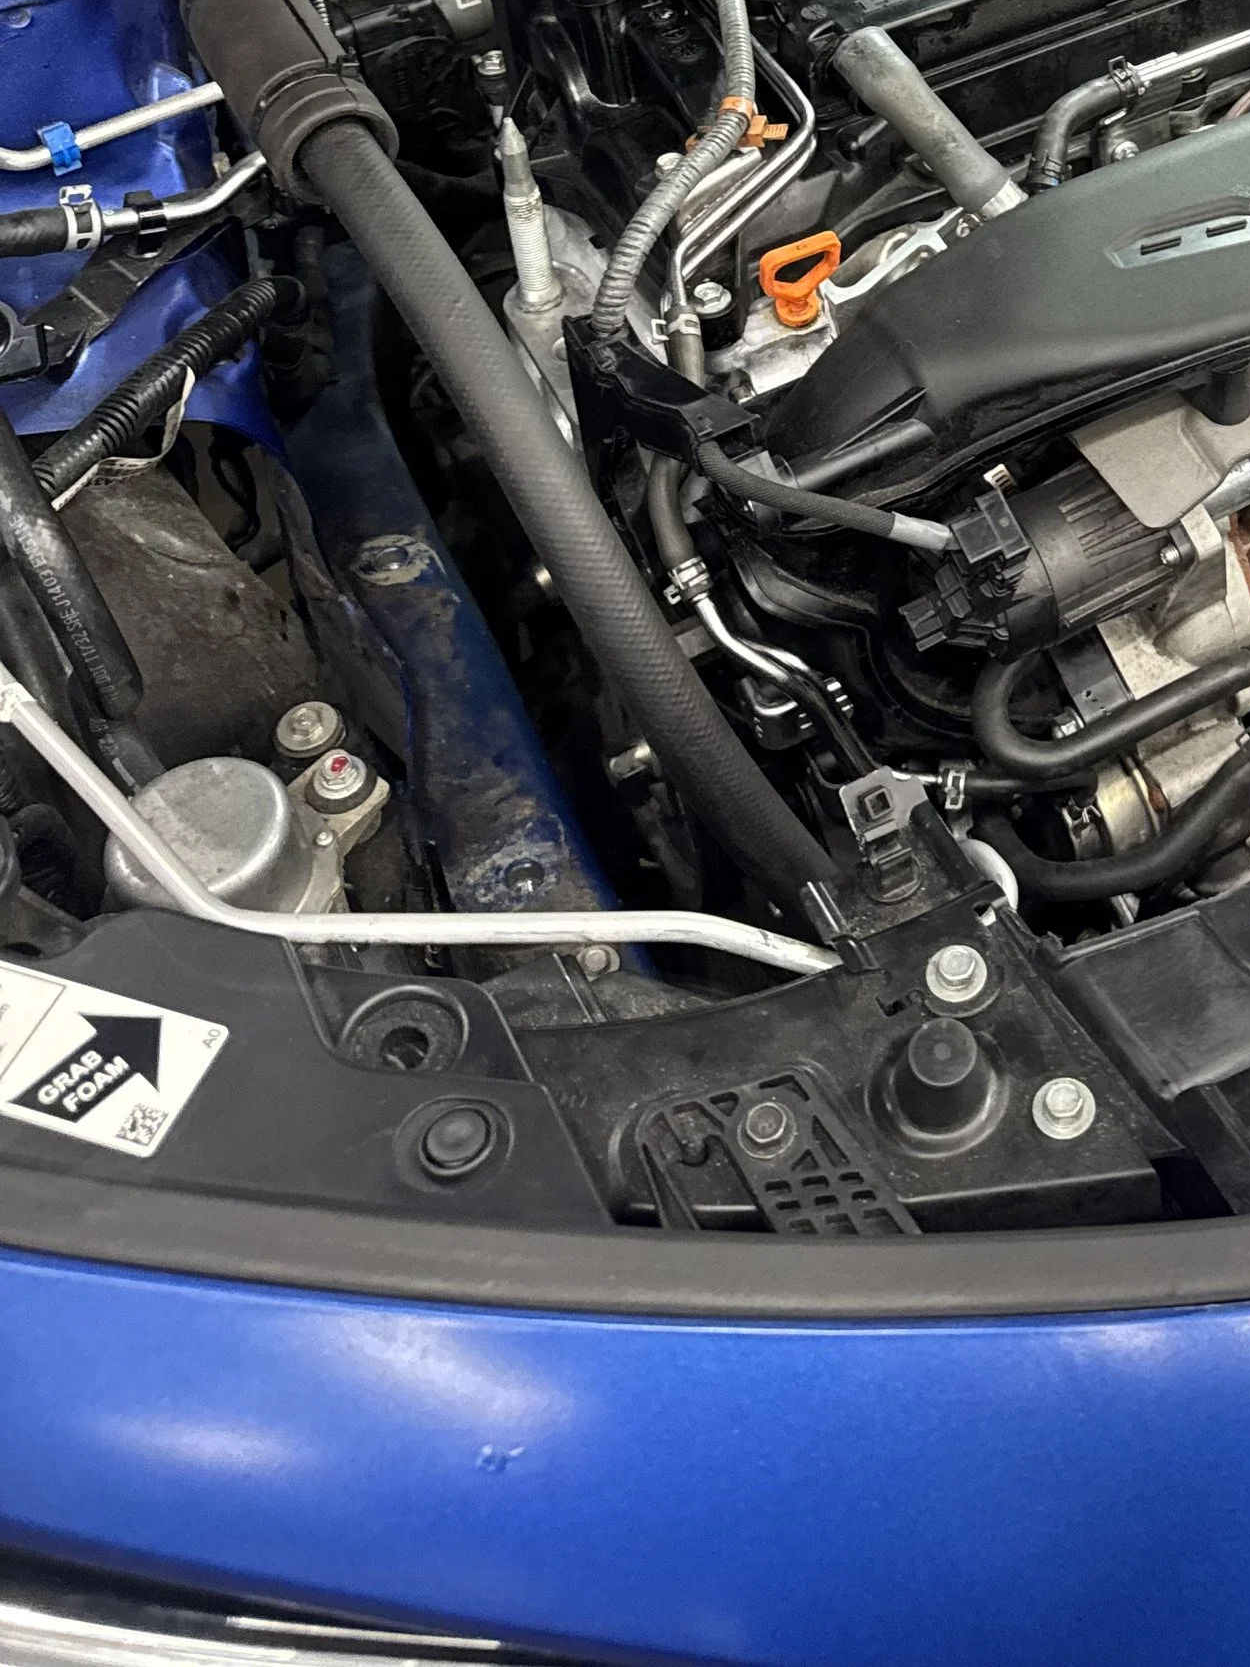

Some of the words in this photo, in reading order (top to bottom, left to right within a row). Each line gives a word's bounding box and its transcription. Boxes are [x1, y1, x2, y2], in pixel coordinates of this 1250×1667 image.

[8, 514, 47, 568] ENGINE
[38, 569, 71, 607] J1403
[60, 608, 82, 632] SAE
[37, 1050, 102, 1105] GRAB
[62, 1055, 130, 1113] FOAM
